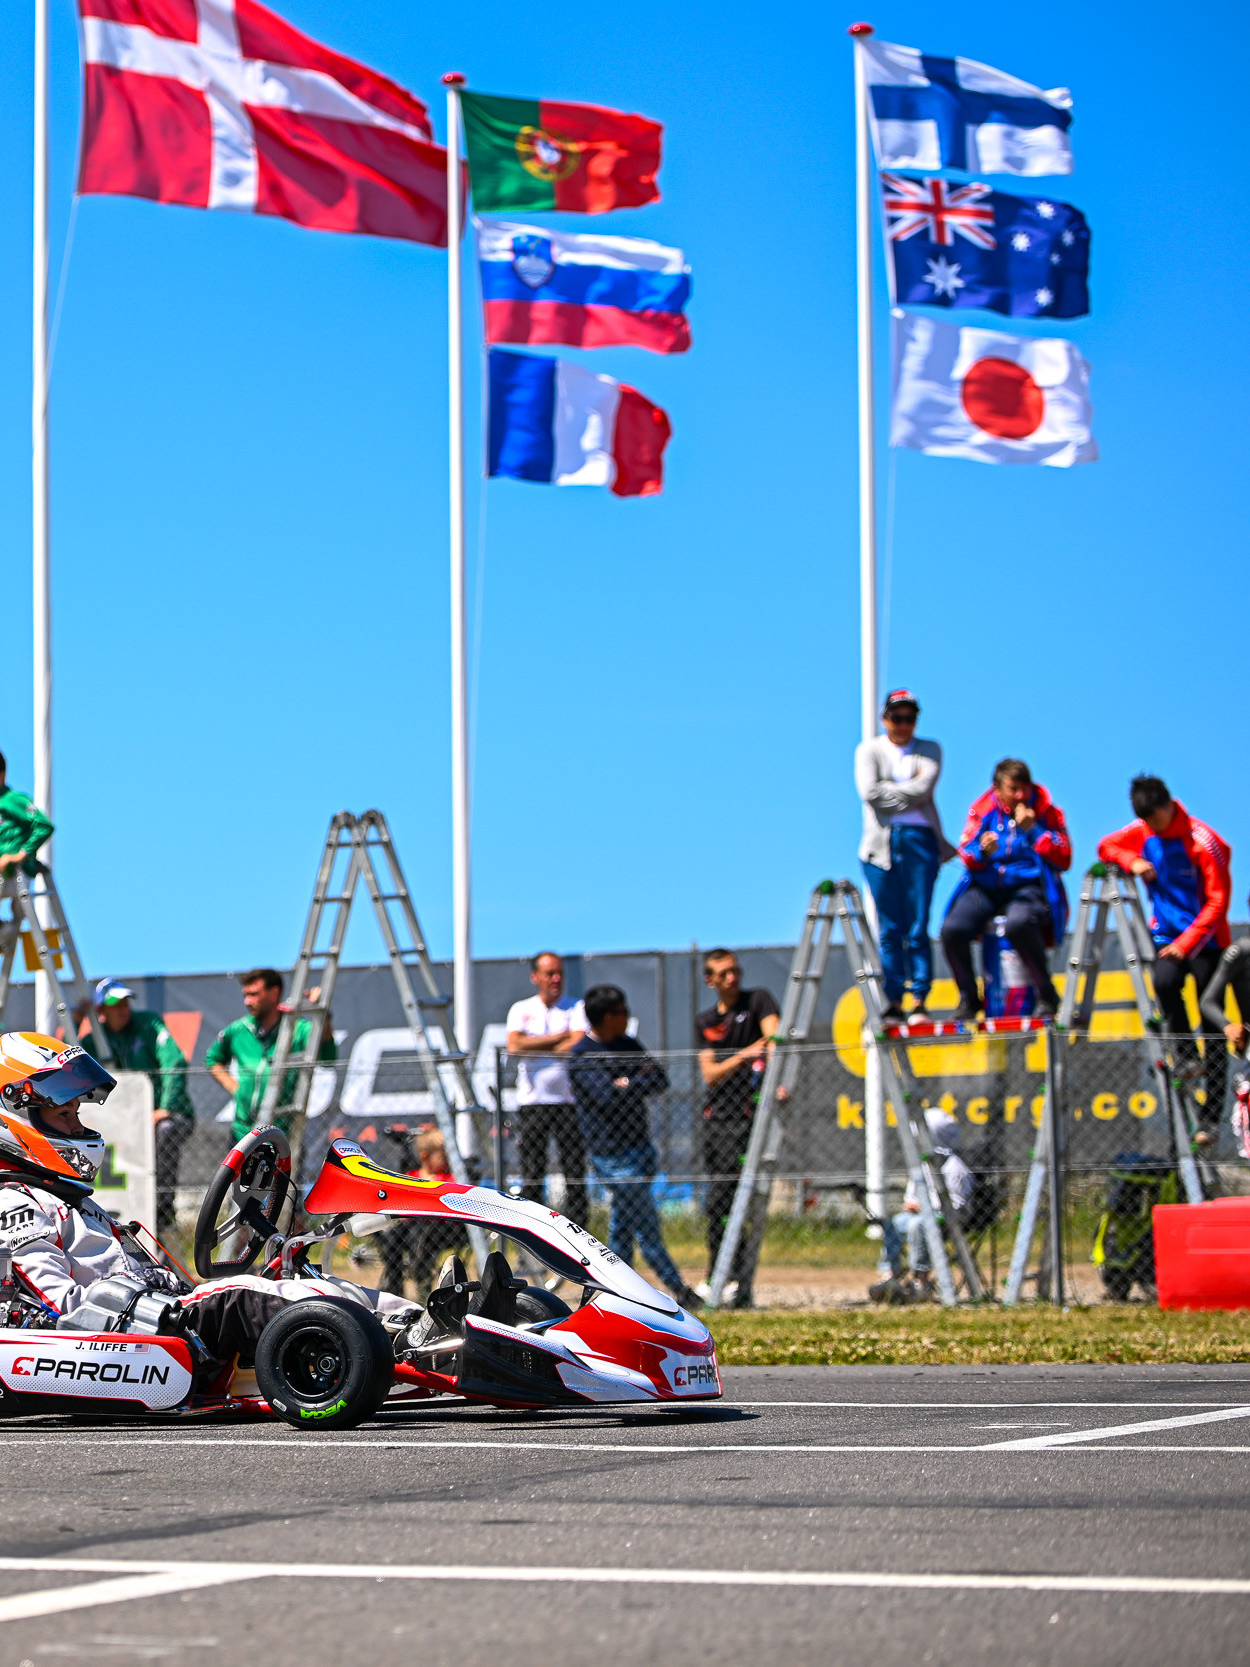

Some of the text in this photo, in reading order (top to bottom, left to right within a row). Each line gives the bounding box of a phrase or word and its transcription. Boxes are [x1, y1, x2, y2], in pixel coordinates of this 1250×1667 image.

[75, 1341, 127, 1353] J. ILIFFE
[33, 1357, 170, 1385] PAROLIN
[300, 1399, 348, 1419] VEGA
